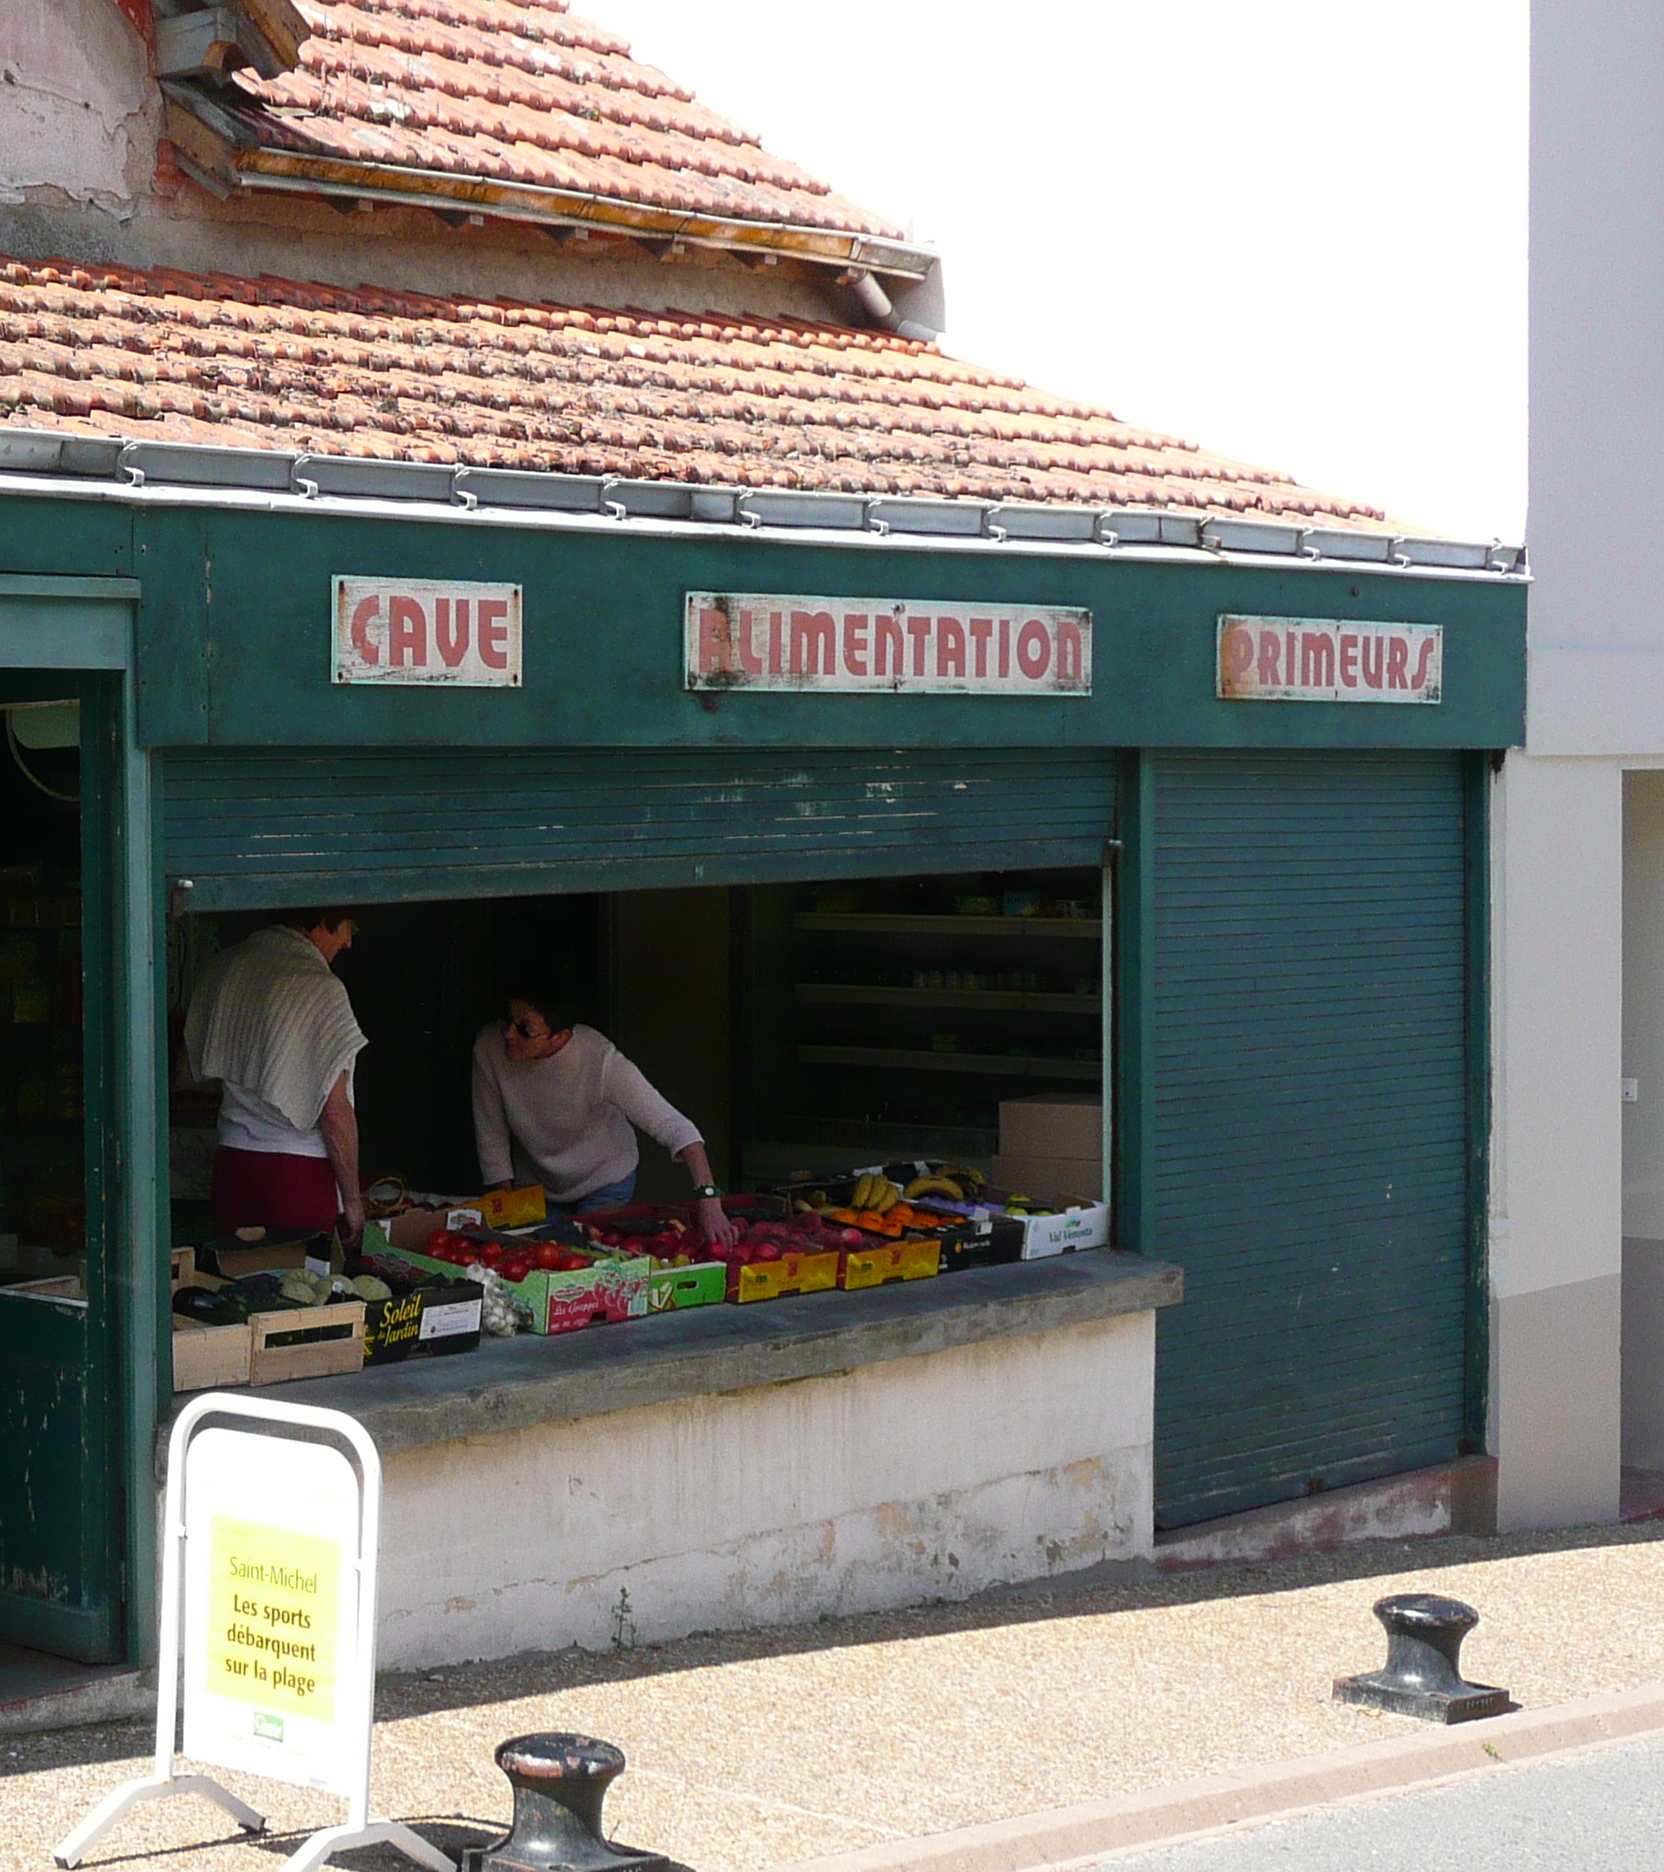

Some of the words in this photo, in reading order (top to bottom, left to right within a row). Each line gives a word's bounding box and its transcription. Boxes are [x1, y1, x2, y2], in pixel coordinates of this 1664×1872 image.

[350, 594, 507, 669] CAVE
[697, 606, 1082, 680] ALIMENTATION
[1230, 629, 1434, 690] PRIMEURS
[379, 1293, 422, 1328] Soleil
[383, 1320, 419, 1348] Jardin
[229, 1556, 318, 1594] Saint-Michel
[233, 1594, 258, 1616] Les
[262, 1604, 312, 1629] sports
[226, 1623, 316, 1662] débarquent
[224, 1657, 250, 1676] sur
[253, 1659, 268, 1681] la
[272, 1667, 316, 1697] plage
